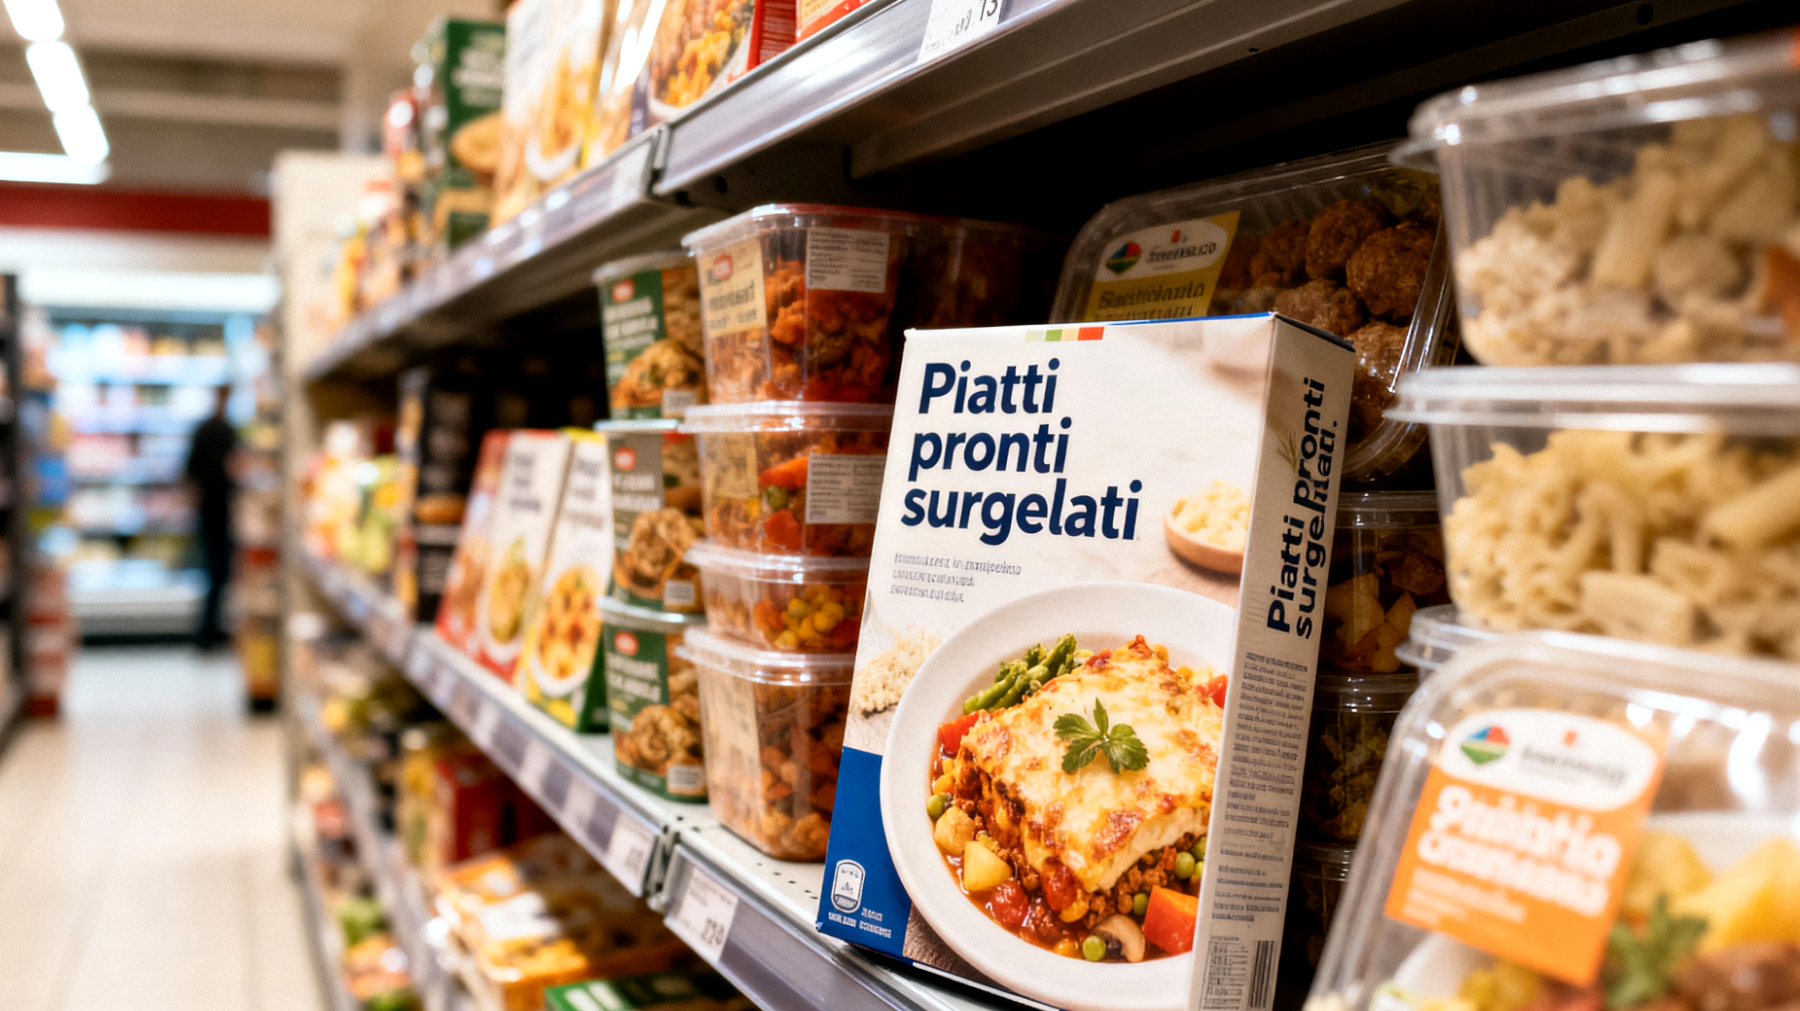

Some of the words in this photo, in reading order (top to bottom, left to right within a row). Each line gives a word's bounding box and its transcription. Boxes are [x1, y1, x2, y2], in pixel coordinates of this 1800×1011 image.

[918, 358, 1060, 414] Piatti
[908, 416, 1071, 482] pronti
[900, 479, 1143, 545] surgelati
[1266, 514, 1306, 633] Piatti
[1293, 376, 1326, 513] pronti
